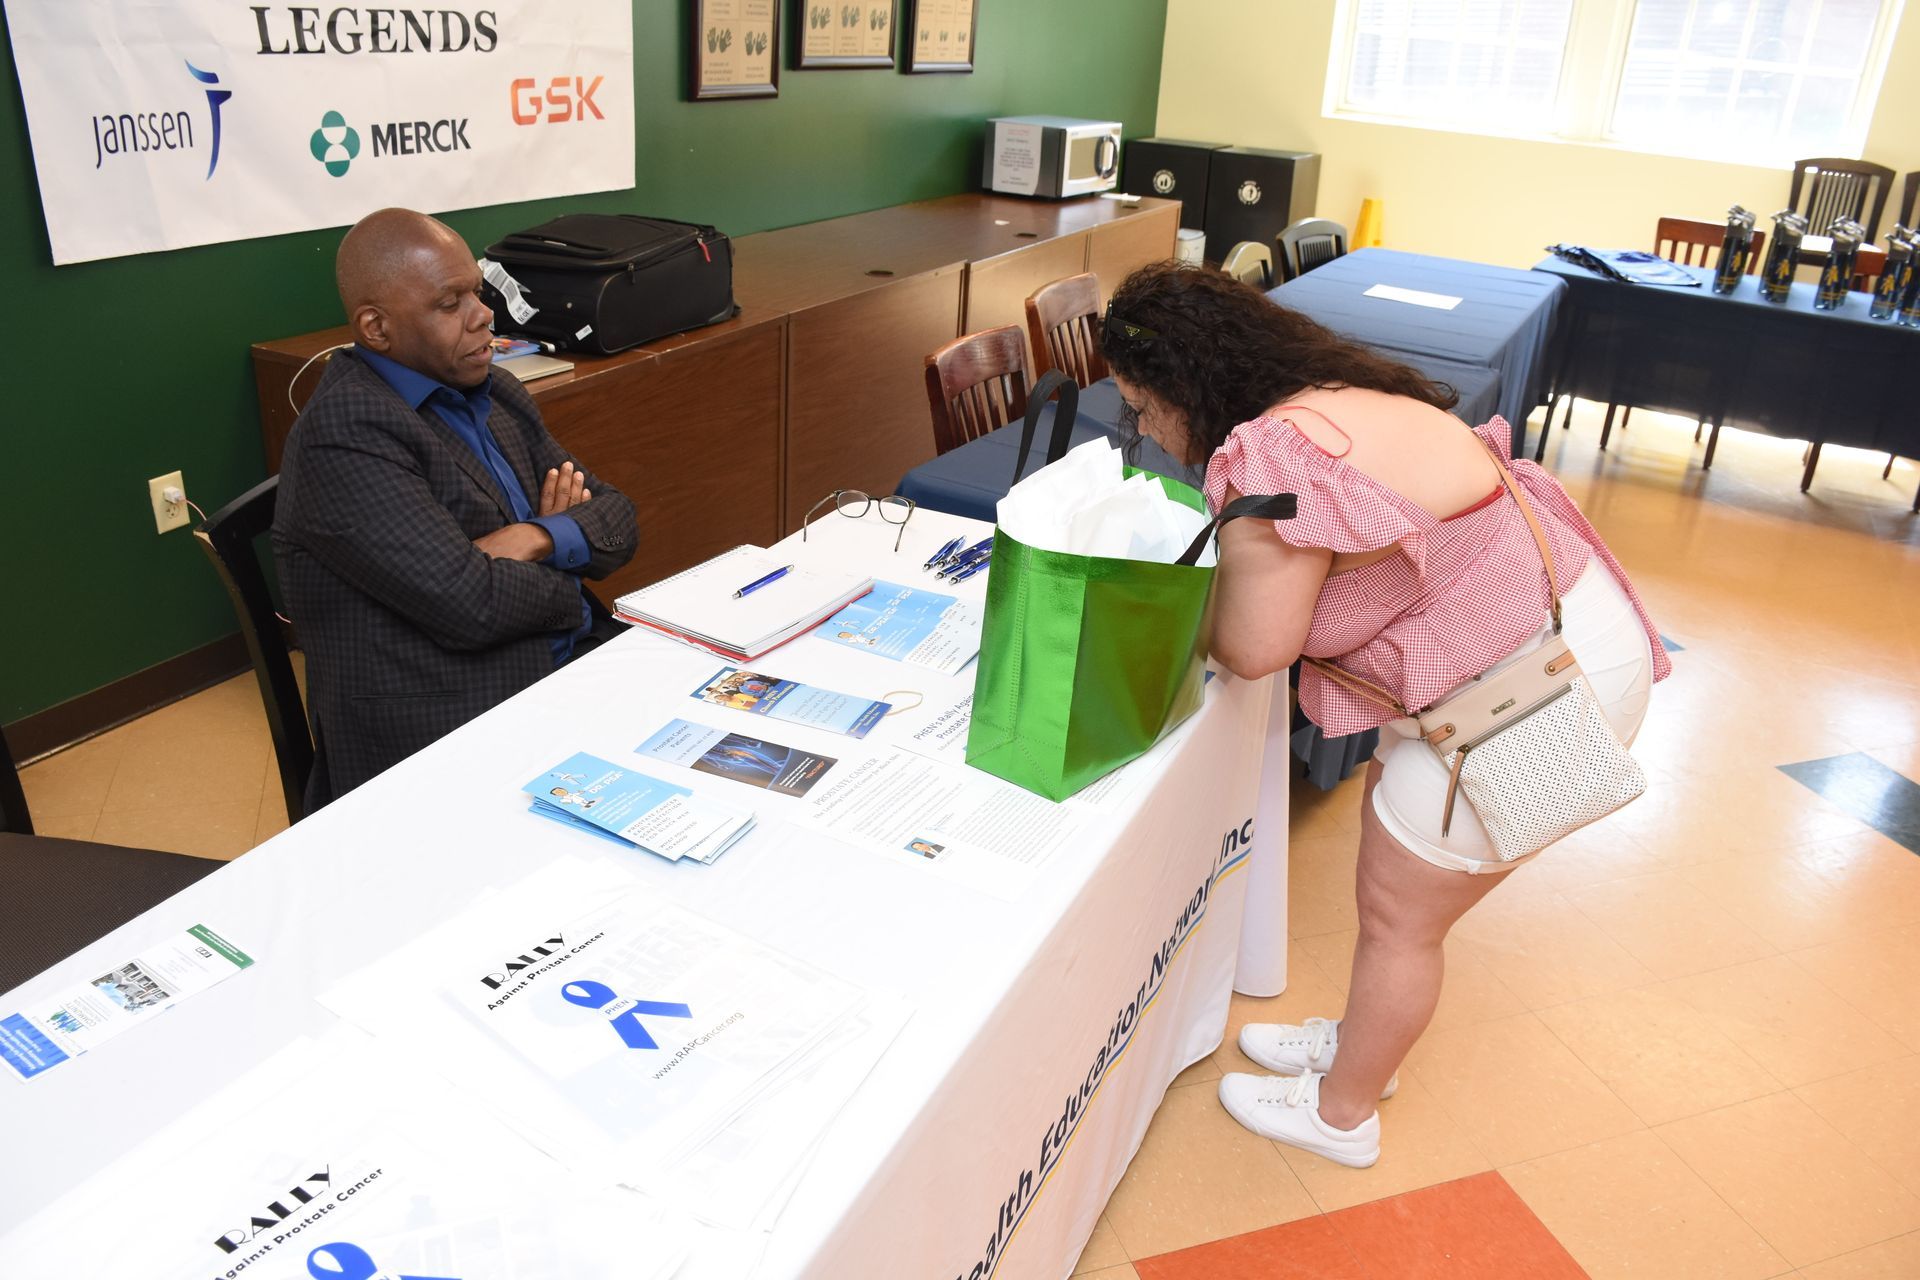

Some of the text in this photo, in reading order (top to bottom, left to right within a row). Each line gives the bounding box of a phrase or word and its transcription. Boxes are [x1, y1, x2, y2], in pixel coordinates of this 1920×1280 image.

[250, 5, 499, 55] LEGENDS
[510, 75, 605, 126] GSK
[371, 119, 471, 158] MERCK
[936, 717, 968, 739] Prostate
[848, 758, 879, 780] CANCER
[480, 932, 565, 990] RALLY
[487, 931, 605, 1011] Against Prostate Cancer
[604, 999, 630, 1016] PHEN
[652, 1010, 746, 1081] www.RAPCancer.org
[955, 1169, 1033, 1280] ealth
[1039, 981, 1147, 1176] Education
[214, 1163, 331, 1255] RALLY
[272, 1202, 336, 1245] Prostate
[336, 1167, 384, 1202] Cancer
